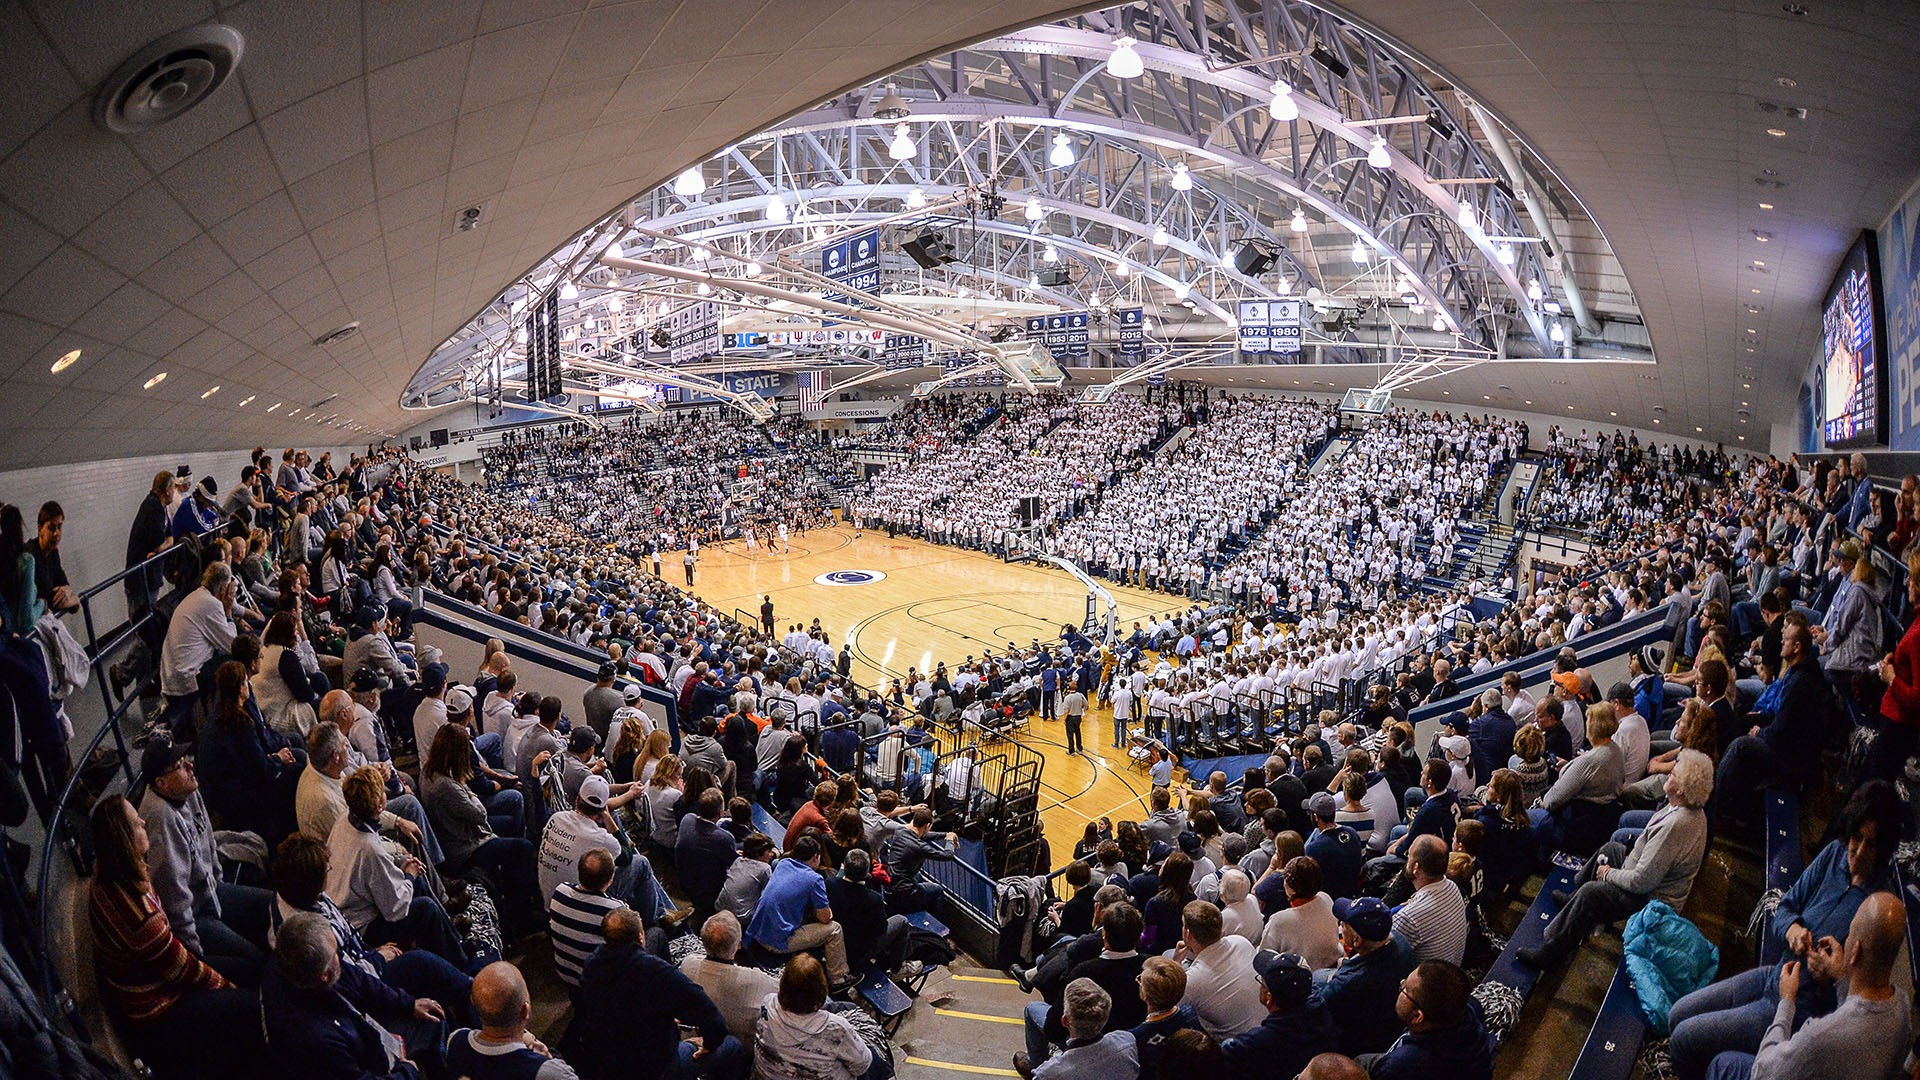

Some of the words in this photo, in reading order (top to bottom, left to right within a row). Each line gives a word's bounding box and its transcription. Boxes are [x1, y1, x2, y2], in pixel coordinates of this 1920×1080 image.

[851, 273, 876, 290] 1994
[1121, 331, 1142, 339] 2012
[1242, 327, 1268, 336] 1978
[1271, 327, 1299, 336] 1980
[1048, 335, 1066, 343] 1953
[1069, 334, 1087, 342] 2011
[690, 381, 731, 400] PEN
[735, 374, 781, 392] STATE
[835, 409, 880, 417] CONCESSIONS
[547, 819, 577, 842] Student
[543, 831, 571, 852] Athletic
[541, 842, 574, 866] Advisory
